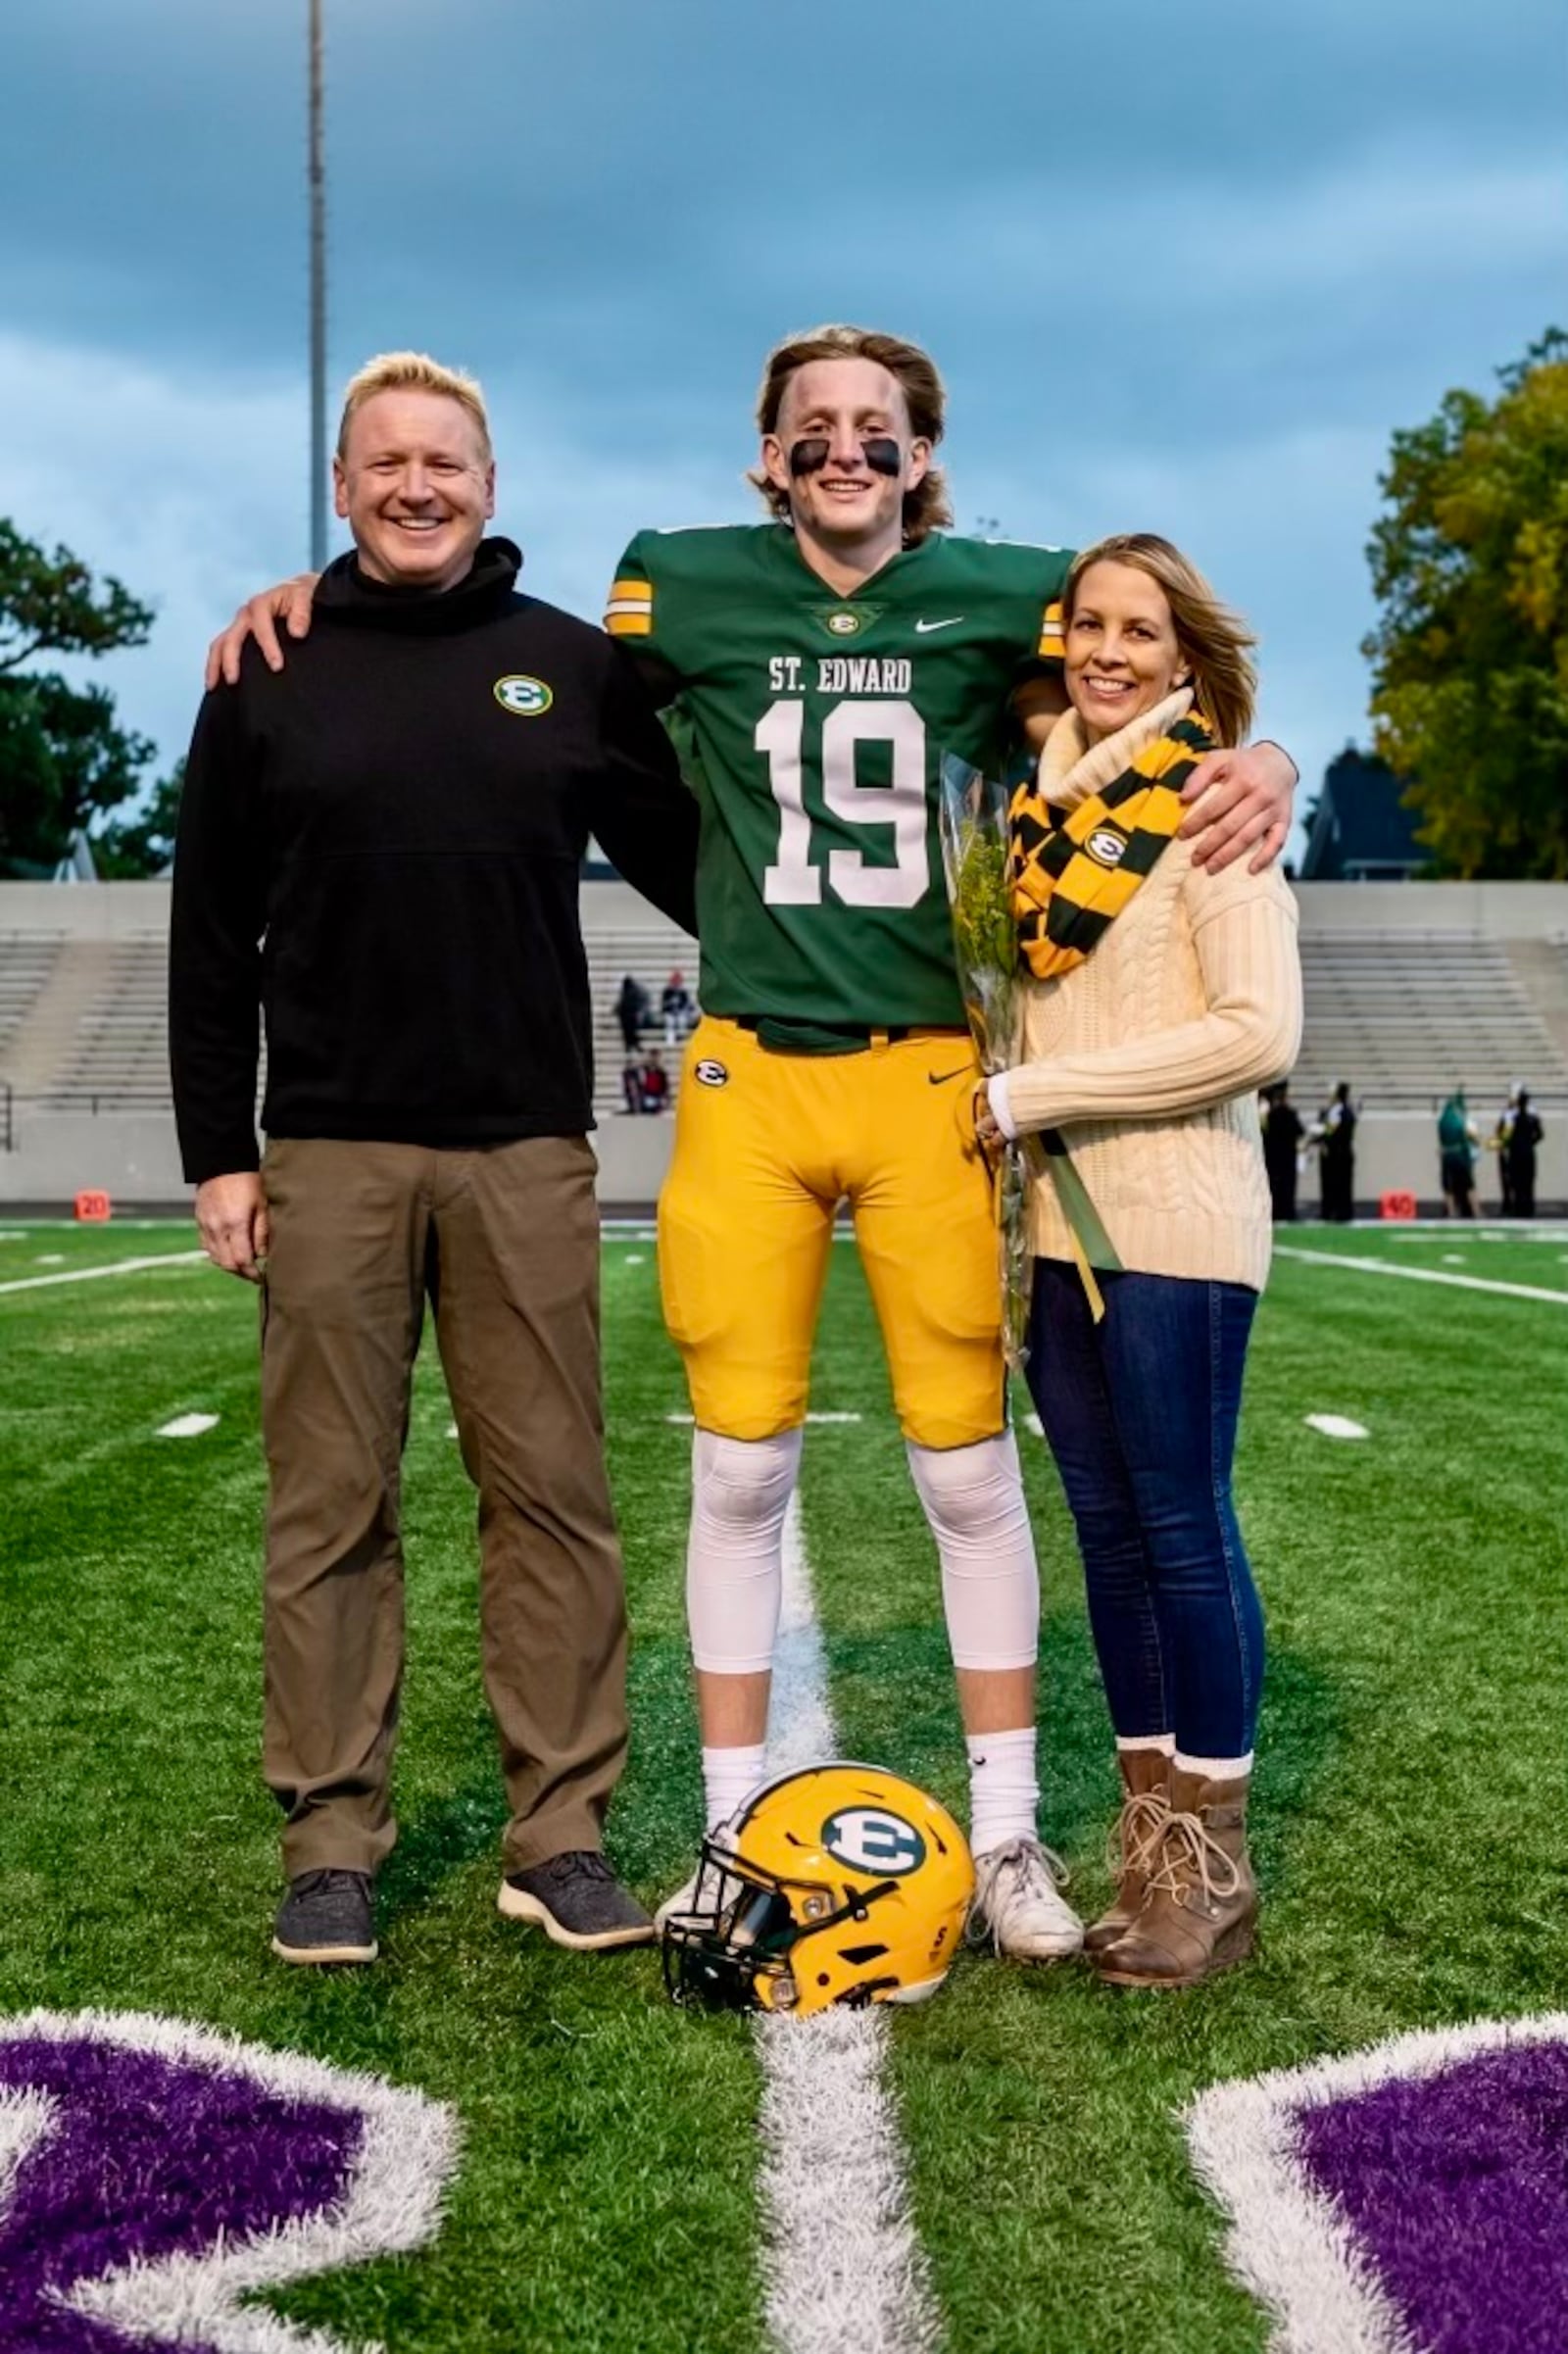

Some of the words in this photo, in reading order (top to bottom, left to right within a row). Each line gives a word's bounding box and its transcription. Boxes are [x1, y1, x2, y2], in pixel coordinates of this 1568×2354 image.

[768, 656, 807, 692] ST.
[815, 658, 911, 694] EDWARD
[499, 679, 546, 711] E
[755, 699, 930, 909] 19
[1089, 831, 1126, 863] E
[696, 1060, 727, 1086] E
[81, 1195, 106, 1215] 20
[1388, 1195, 1413, 1217] 40
[828, 1810, 917, 1872] E
